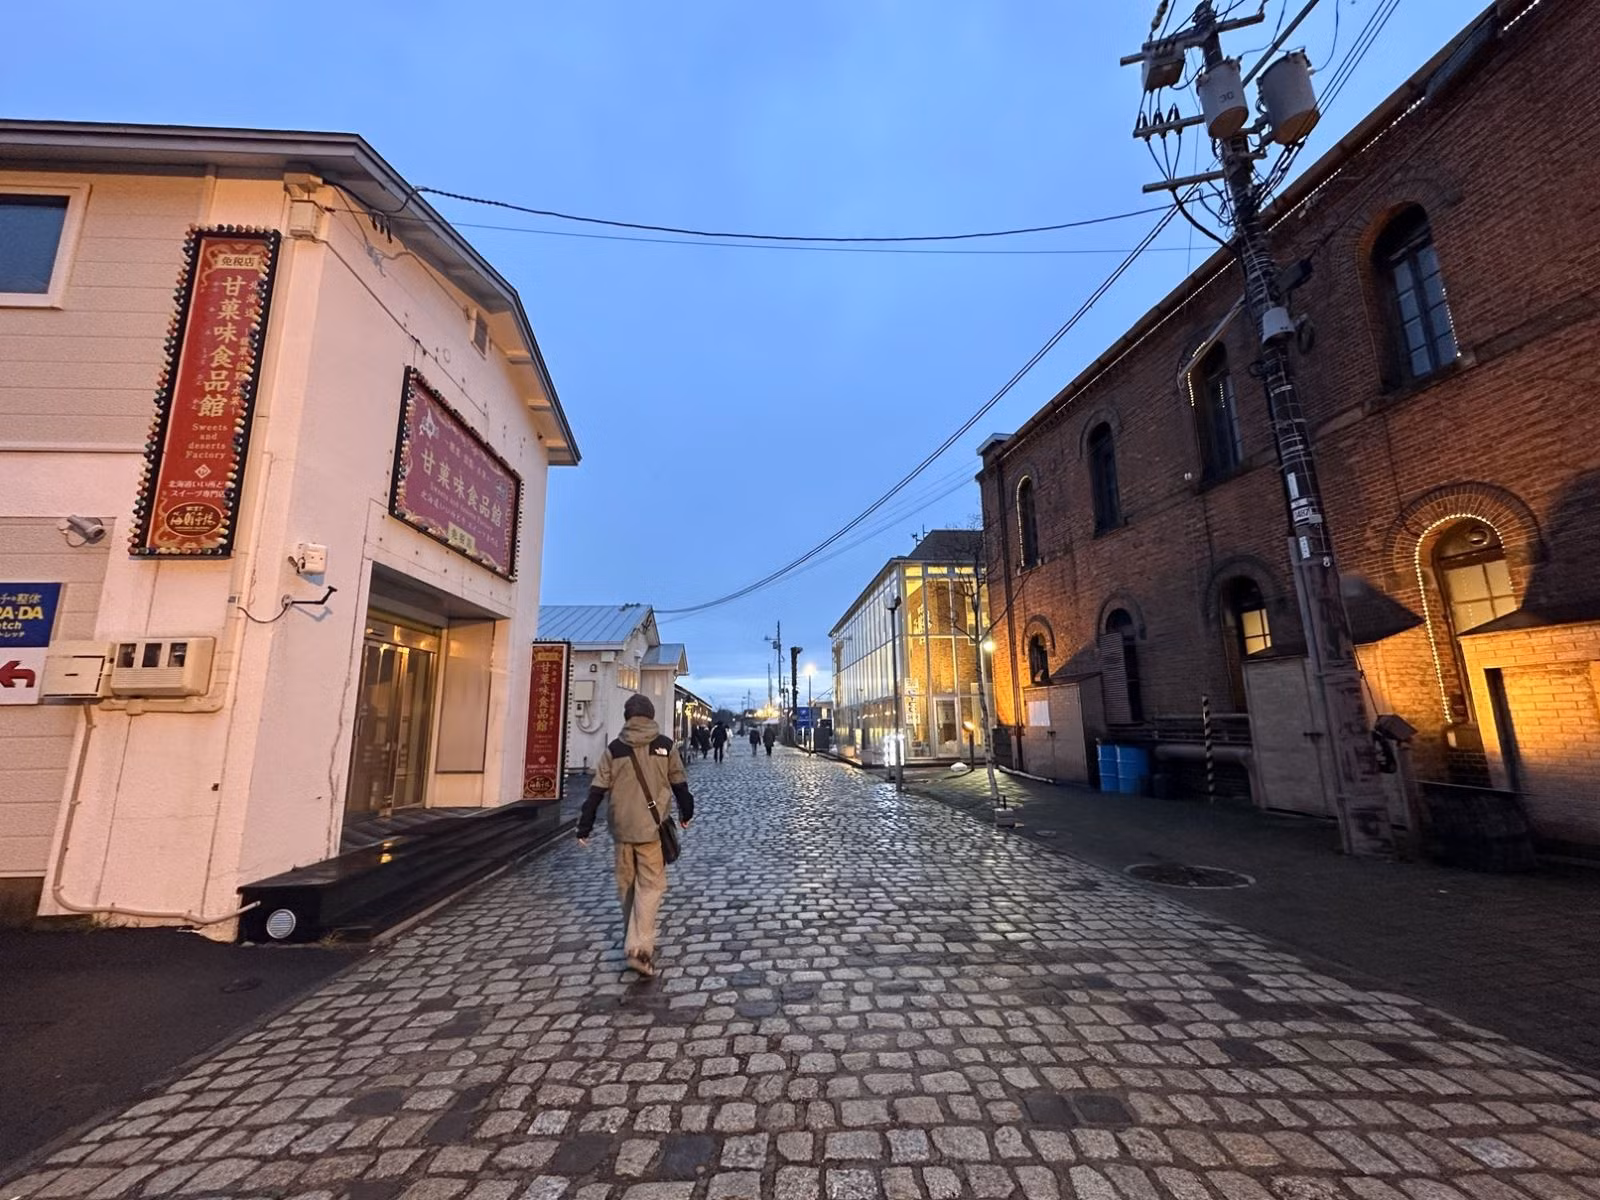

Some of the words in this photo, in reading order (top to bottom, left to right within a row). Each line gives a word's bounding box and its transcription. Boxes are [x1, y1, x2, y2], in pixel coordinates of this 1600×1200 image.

[221, 256, 256, 268] 免税店
[197, 275, 247, 418] 甘菓味食品館
[192, 423, 228, 431] Sweets
[188, 442, 226, 450] deserts
[185, 451, 227, 460] Factory
[420, 447, 502, 528] 甘菓味食品館
